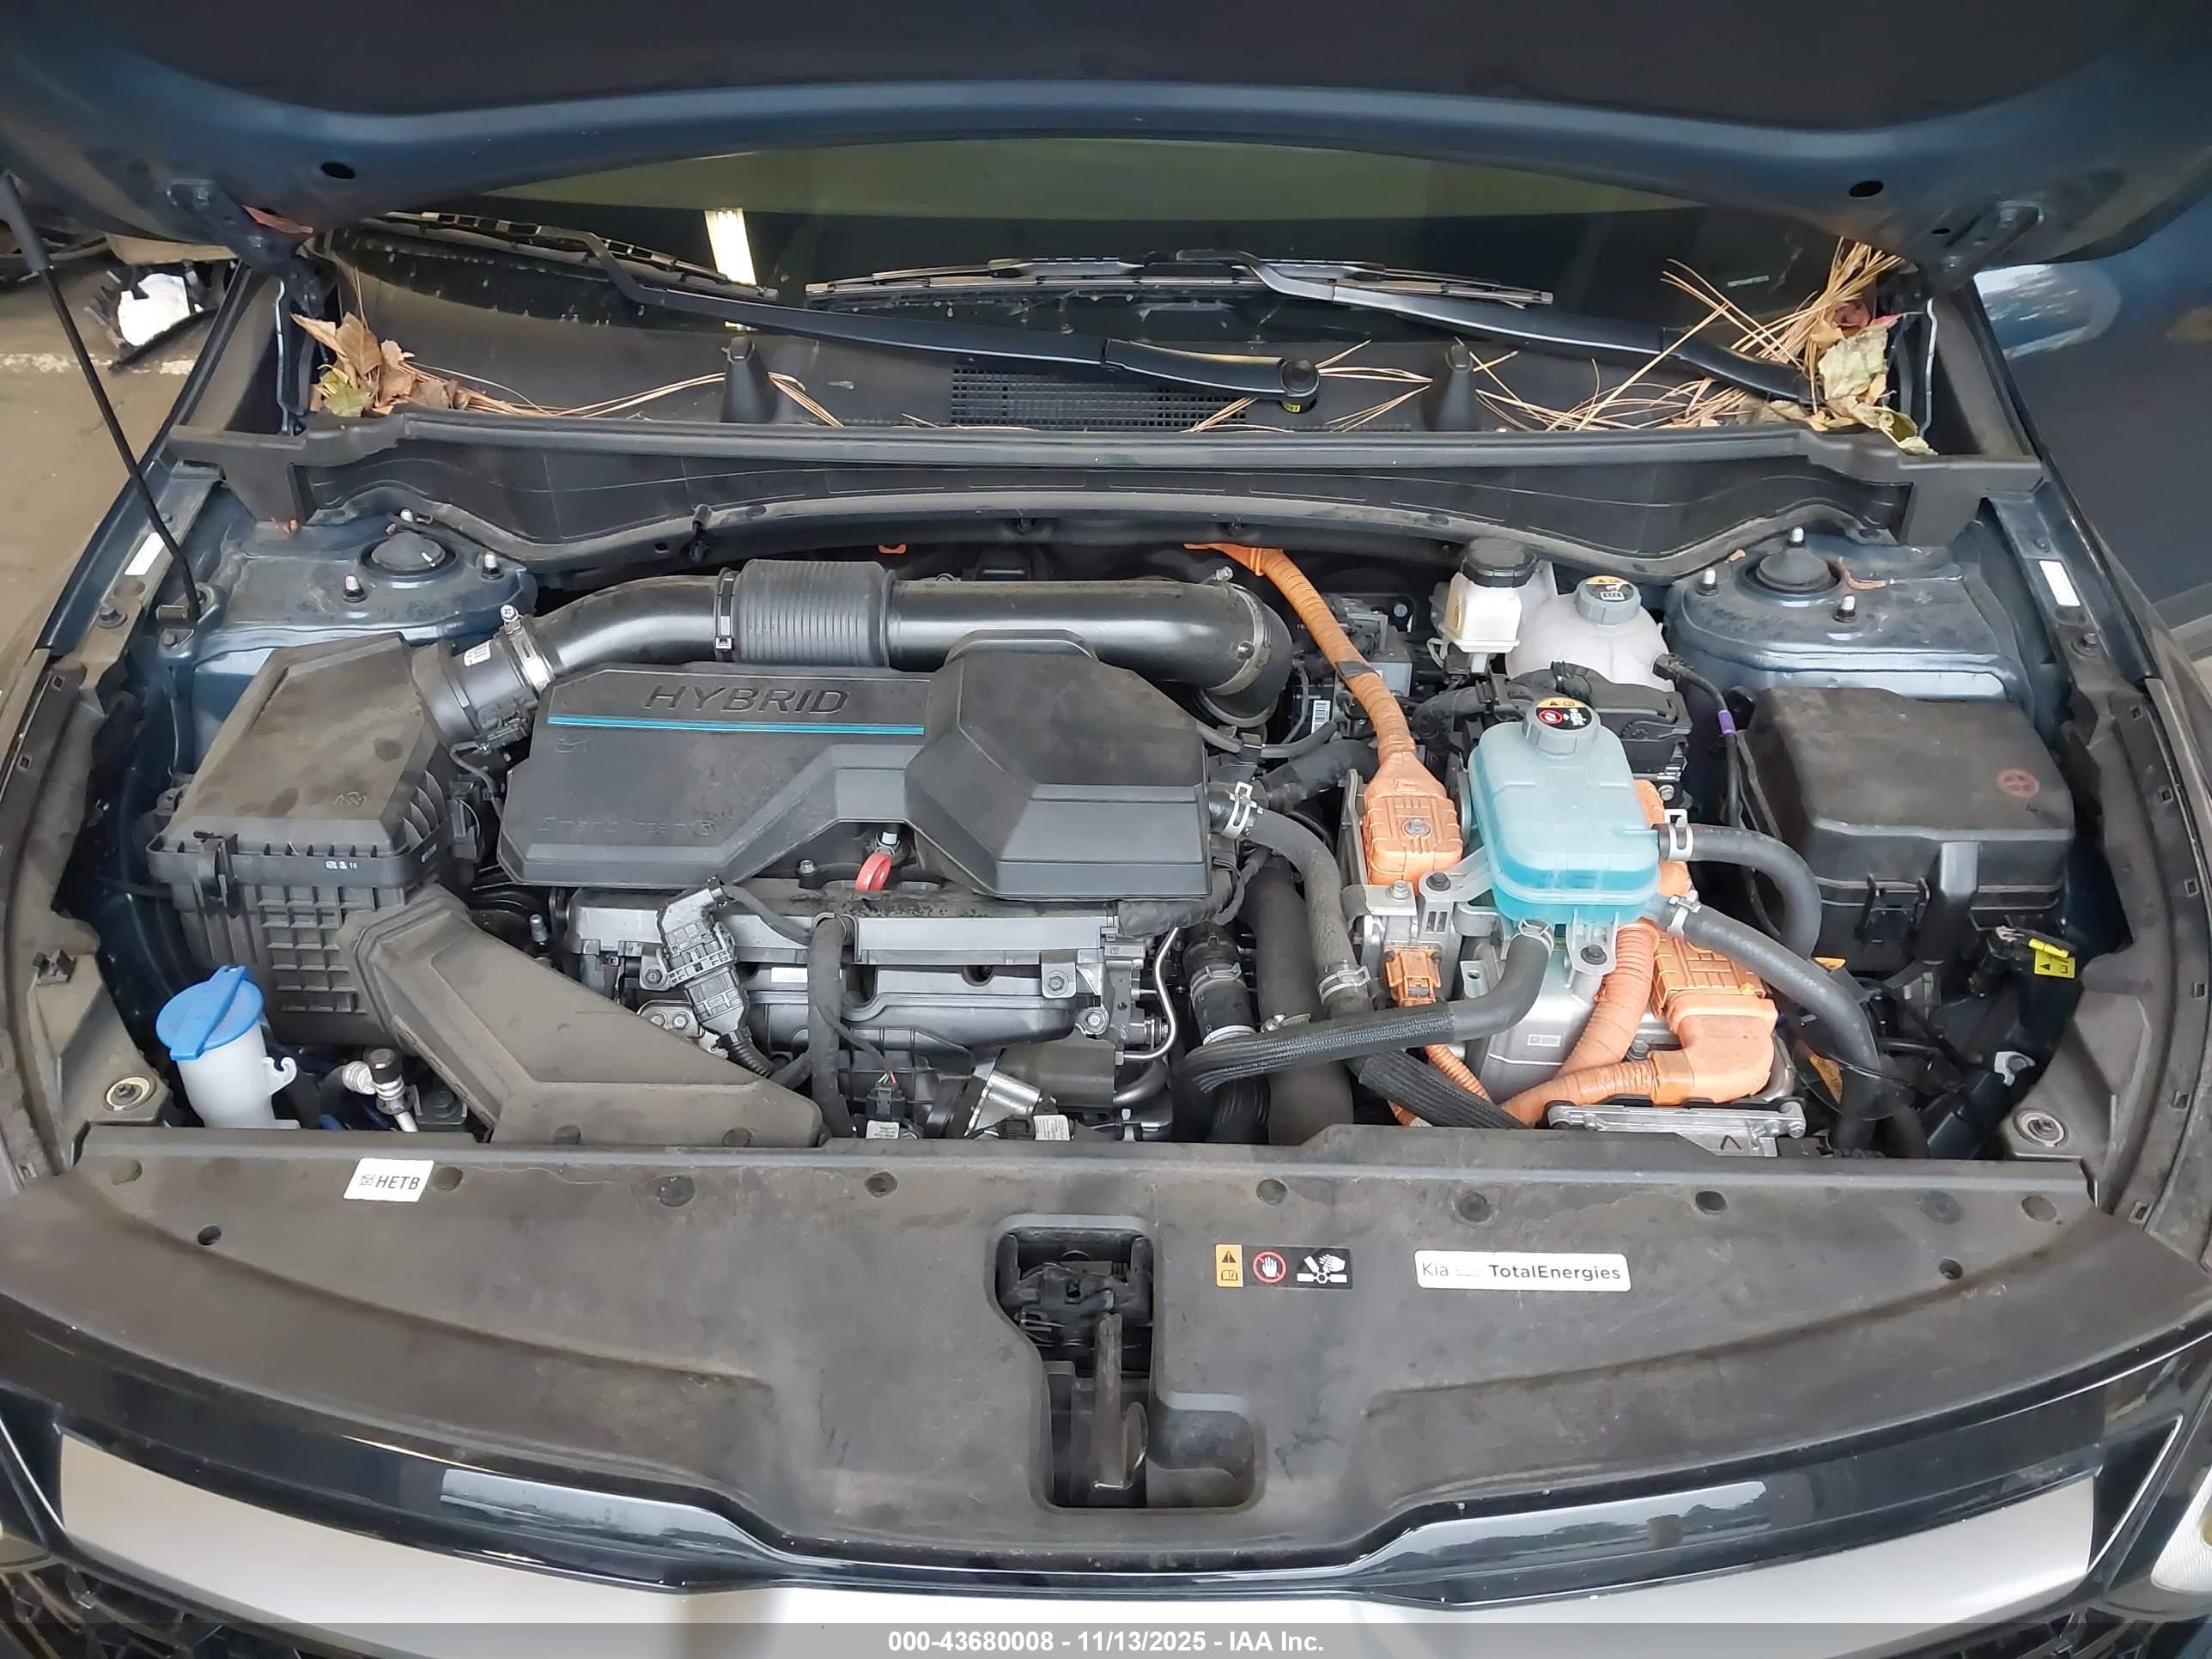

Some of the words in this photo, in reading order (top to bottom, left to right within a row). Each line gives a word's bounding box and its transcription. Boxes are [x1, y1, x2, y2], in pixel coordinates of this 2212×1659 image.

[644, 685, 850, 714] HYBRID
[375, 1176, 421, 1190] HETB
[1422, 1262, 1449, 1277] Kia
[1488, 1265, 1621, 1282] TotalEnergies
